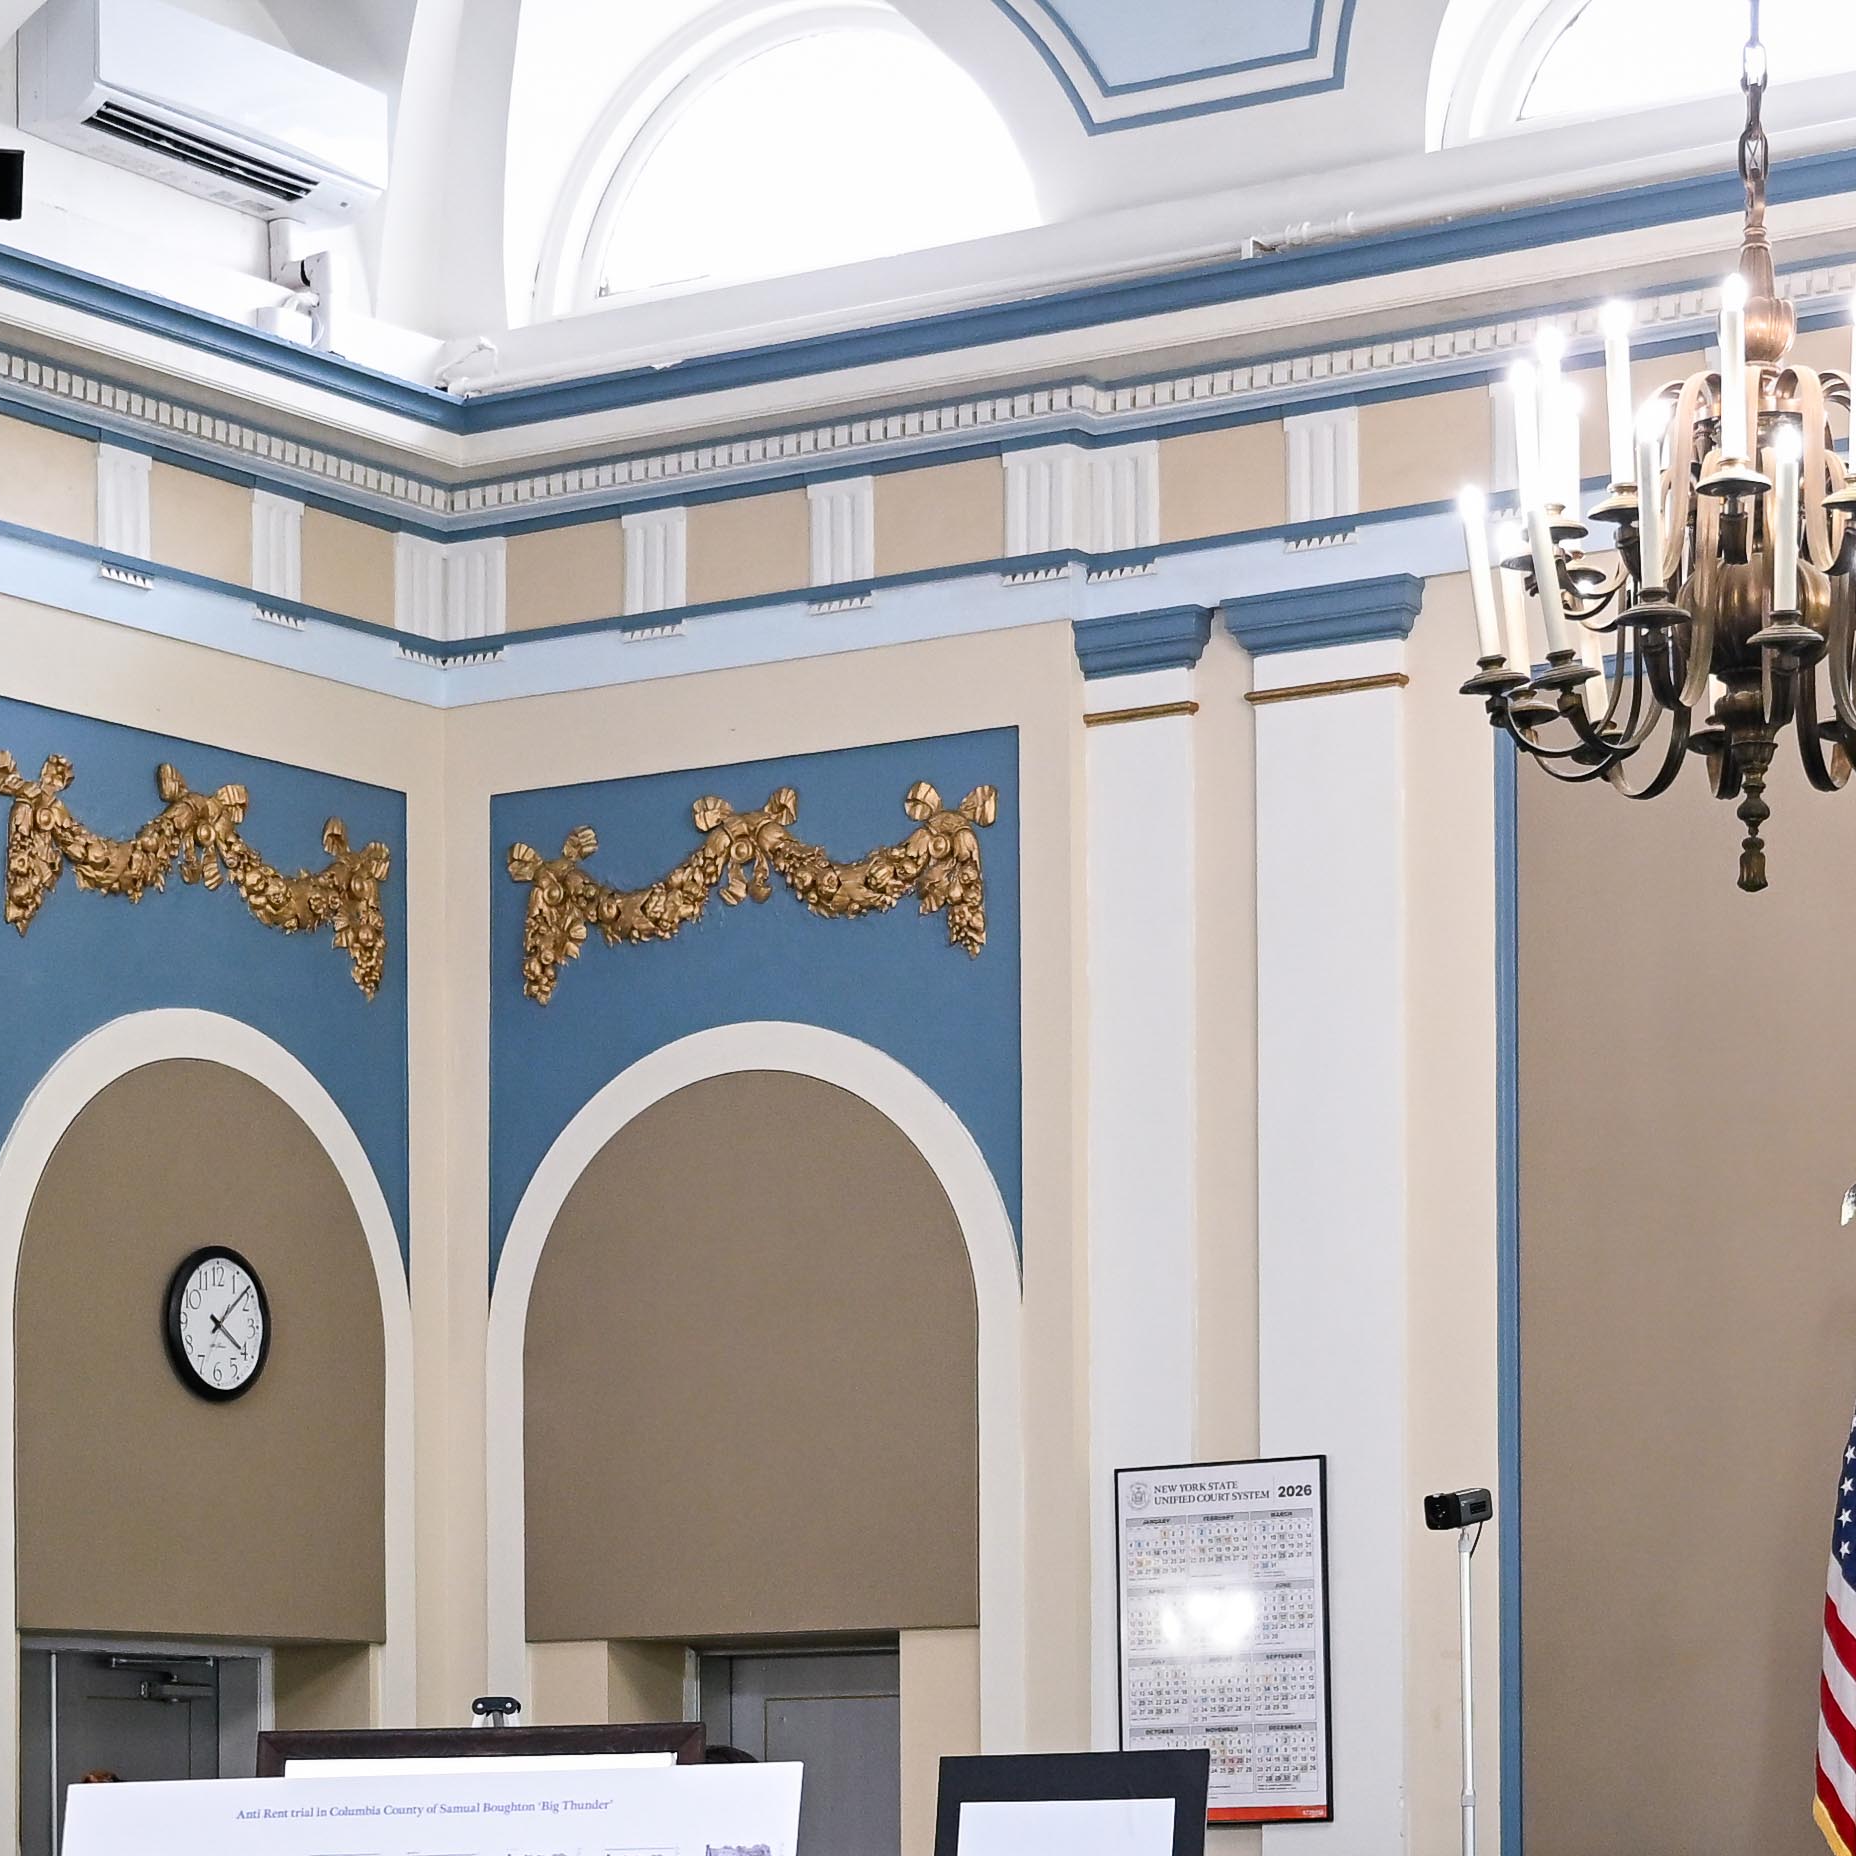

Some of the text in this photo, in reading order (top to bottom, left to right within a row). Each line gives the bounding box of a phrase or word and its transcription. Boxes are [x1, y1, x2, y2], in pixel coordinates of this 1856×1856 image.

[199, 1270, 208, 1290] 11
[212, 1266, 224, 1287] 12
[232, 1275, 236, 1294] 1
[186, 1289, 201, 1309] 10
[243, 1292, 250, 1311] 2
[180, 1312, 188, 1330] 9
[247, 1318, 256, 1339] 3
[185, 1335, 194, 1355] 8
[241, 1342, 248, 1361] 4
[198, 1355, 205, 1375] 7
[213, 1362, 222, 1382] 6
[230, 1358, 238, 1378] 5
[1154, 1481, 1238, 1494] NEW YORK STATE
[1278, 1485, 1312, 1497] 2026
[1154, 1490, 1269, 1505] UNIFIED COURT SYSTEM
[236, 1809, 260, 1820] Anti
[263, 1808, 288, 1818] Rent
[291, 1808, 314, 1818] trial
[316, 1808, 327, 1817] in
[330, 1806, 380, 1816] Columbia
[384, 1805, 424, 1818] County
[427, 1803, 438, 1814] of
[440, 1803, 480, 1813] Samual
[483, 1802, 535, 1815] Boughton
